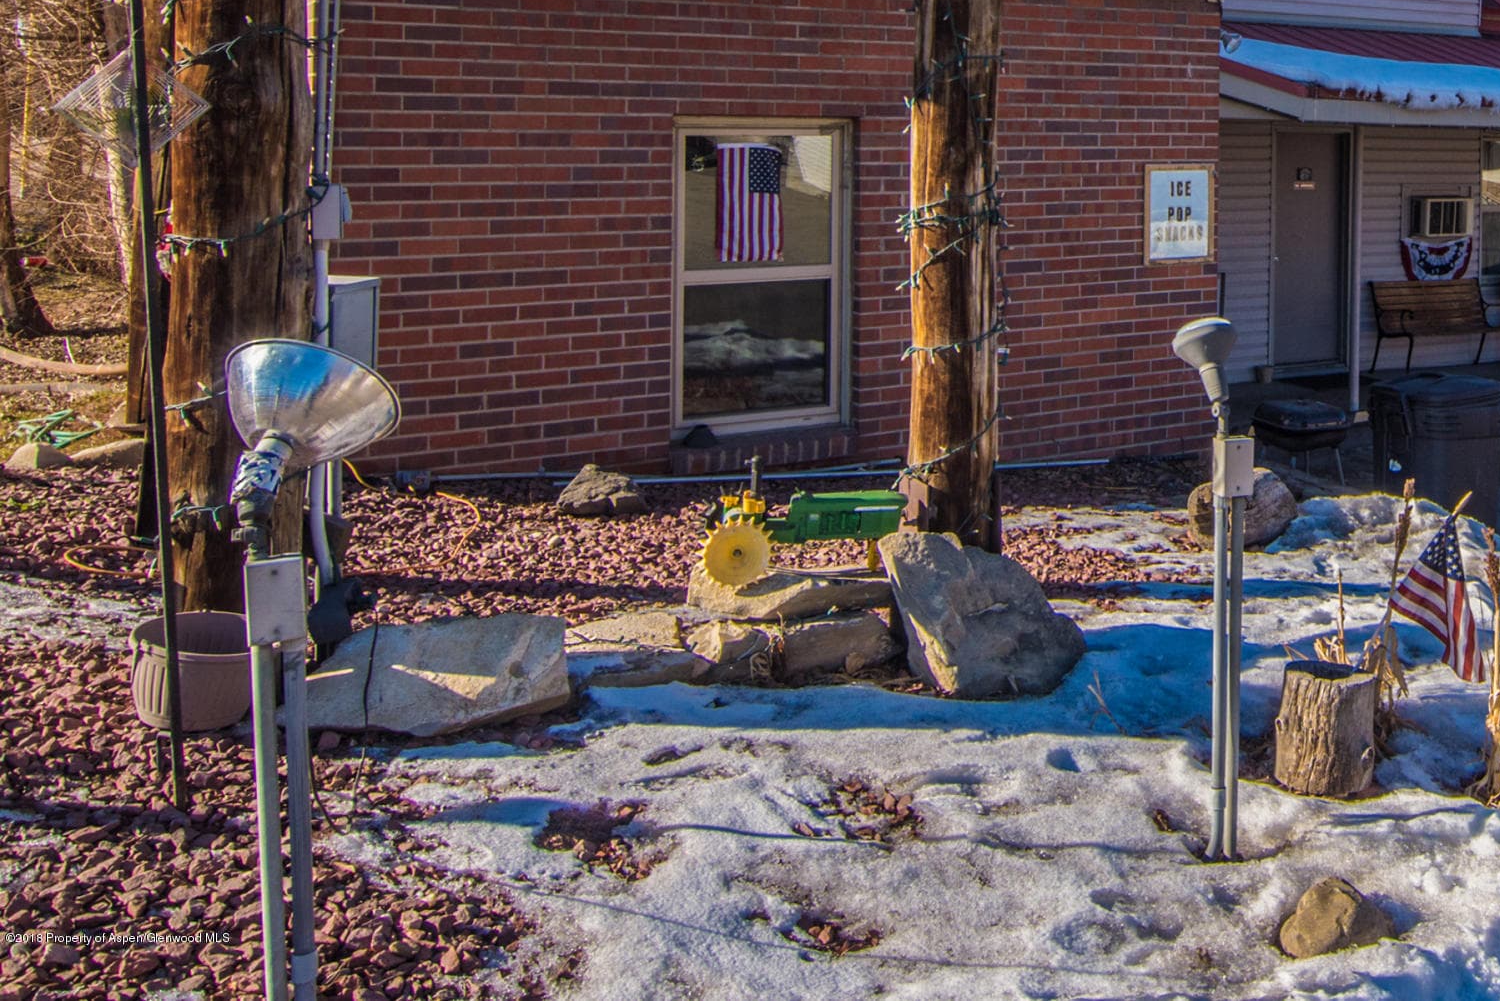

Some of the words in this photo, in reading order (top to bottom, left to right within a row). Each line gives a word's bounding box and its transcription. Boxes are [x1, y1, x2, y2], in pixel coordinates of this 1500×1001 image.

[1170, 181, 1192, 197] ICE
[1168, 207, 1192, 222] POP
[1155, 225, 1203, 242] SNACKS
